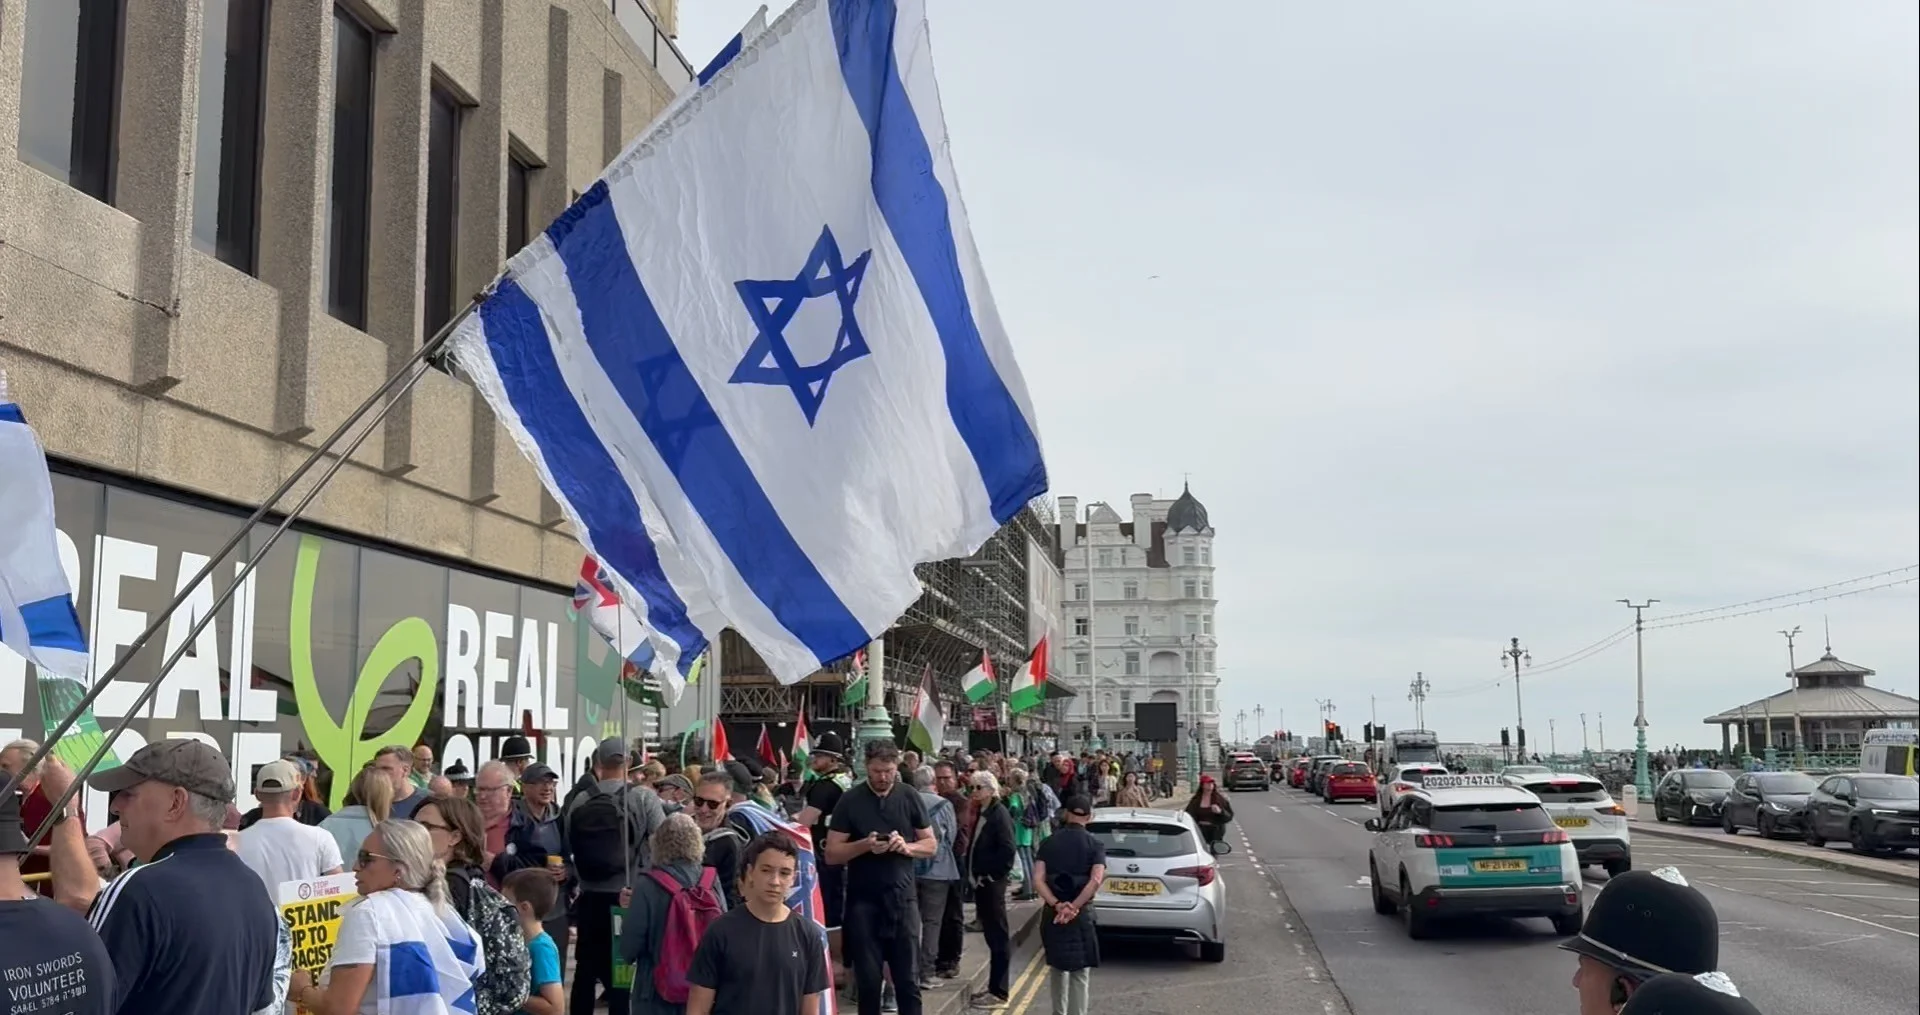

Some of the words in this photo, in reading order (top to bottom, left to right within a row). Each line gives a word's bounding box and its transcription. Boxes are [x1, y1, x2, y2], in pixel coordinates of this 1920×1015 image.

[444, 603, 569, 730] REAL
[313, 880, 329, 890] STOP
[313, 888, 324, 897] THE
[324, 886, 341, 895] HATE
[284, 900, 342, 928] STAND
[308, 924, 328, 945] TO
[3, 966, 32, 981] IRON
[36, 951, 83, 976] SWORDS
[8, 968, 86, 1001] VOLUNTEER
[41, 994, 60, 1009] 5784
